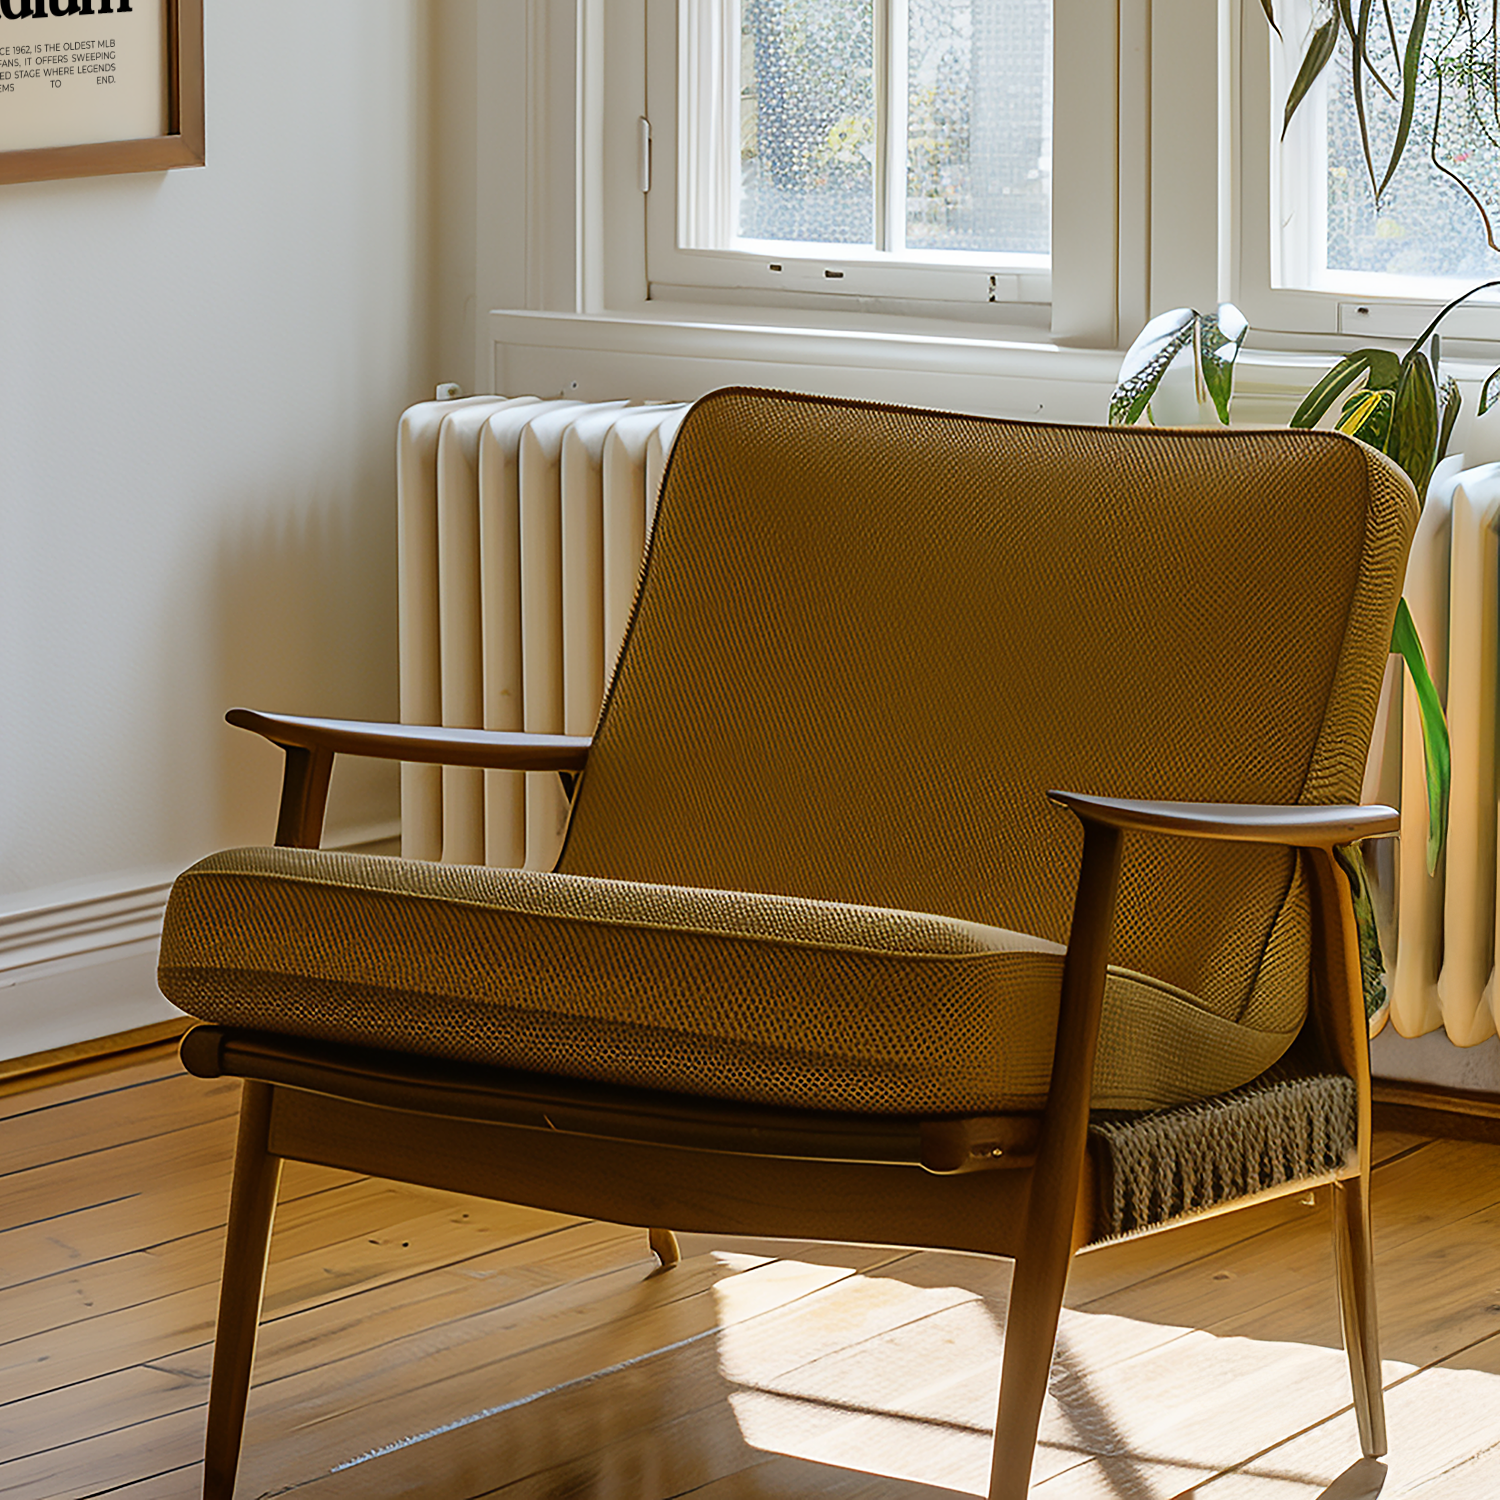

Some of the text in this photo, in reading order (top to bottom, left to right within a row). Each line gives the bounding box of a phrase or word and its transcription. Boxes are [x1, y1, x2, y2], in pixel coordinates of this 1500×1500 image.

[35, 45, 42, 53] IS
[44, 43, 60, 52] THE
[63, 41, 95, 51] OLDEST
[98, 39, 115, 48] MLB
[25, 57, 32, 66] IT
[35, 55, 68, 65] OFFERS
[72, 51, 115, 62] SWEEPING
[14, 69, 40, 79] STAGE
[43, 66, 74, 76] WHERE
[78, 63, 116, 74] LEGENDS
[50, 80, 61, 88] TO
[97, 75, 115, 85] END.
